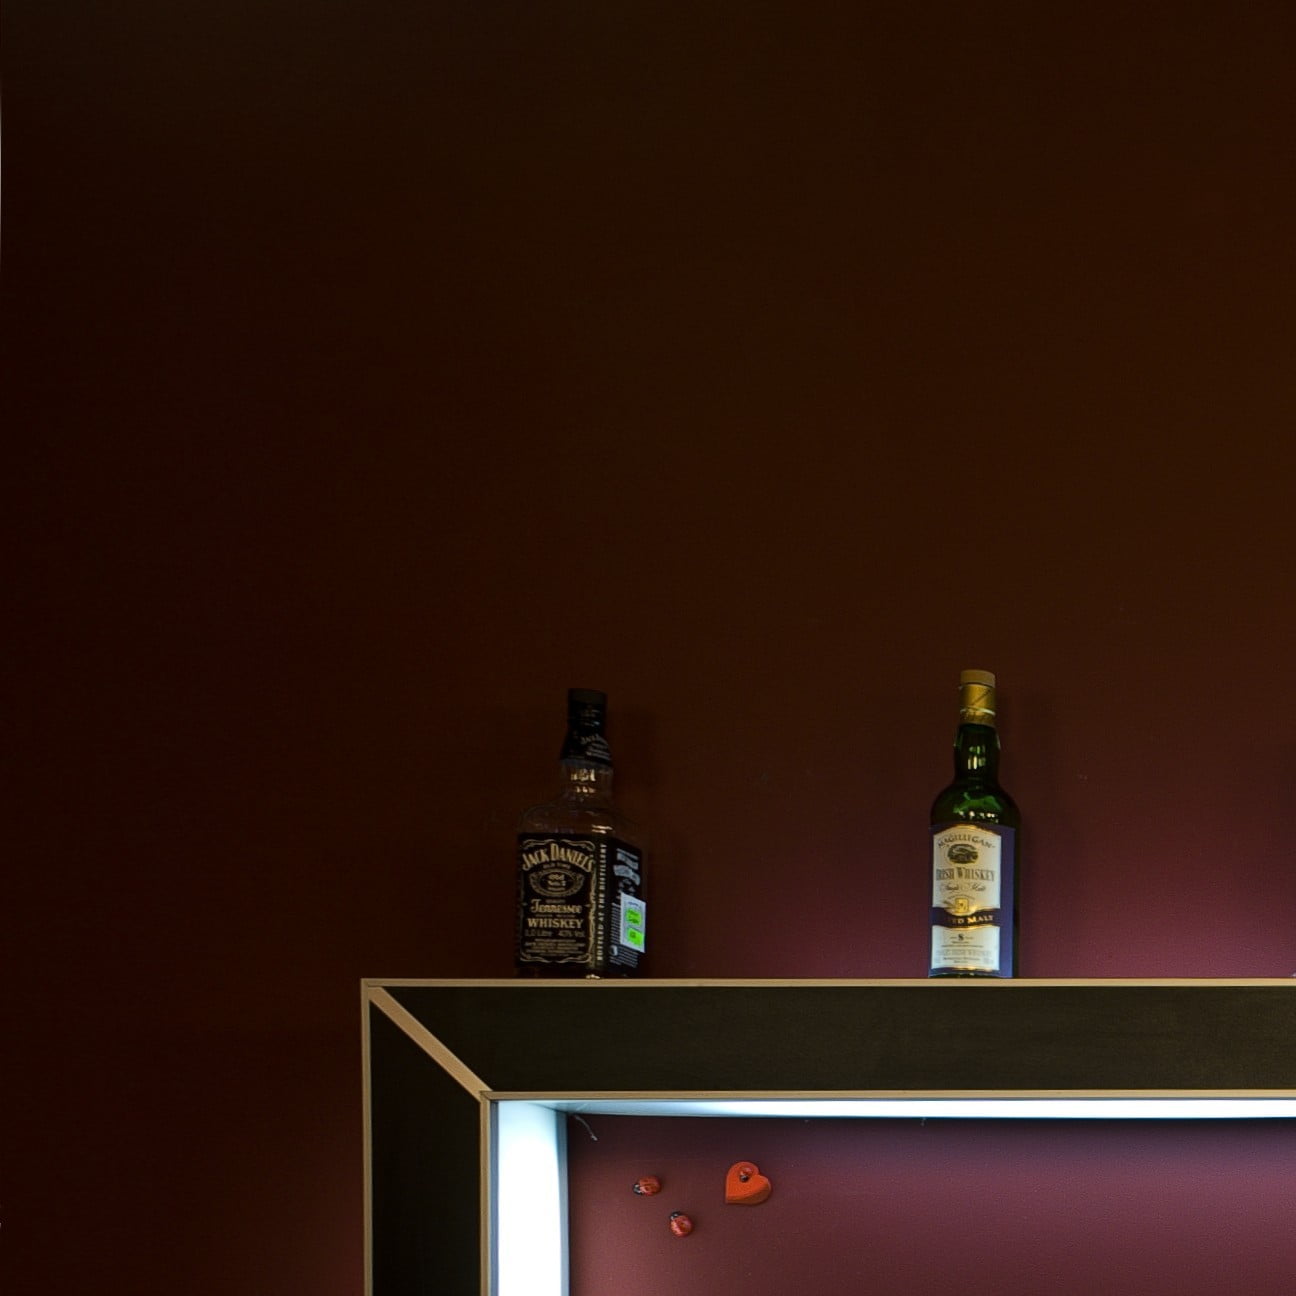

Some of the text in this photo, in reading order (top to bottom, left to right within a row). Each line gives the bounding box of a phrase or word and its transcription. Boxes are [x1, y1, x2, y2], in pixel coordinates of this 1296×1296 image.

[522, 849, 550, 871] JACK
[550, 843, 596, 872] DANIEL'S
[957, 866, 996, 882] WHISKEY
[527, 918, 584, 929] WHISKEY
